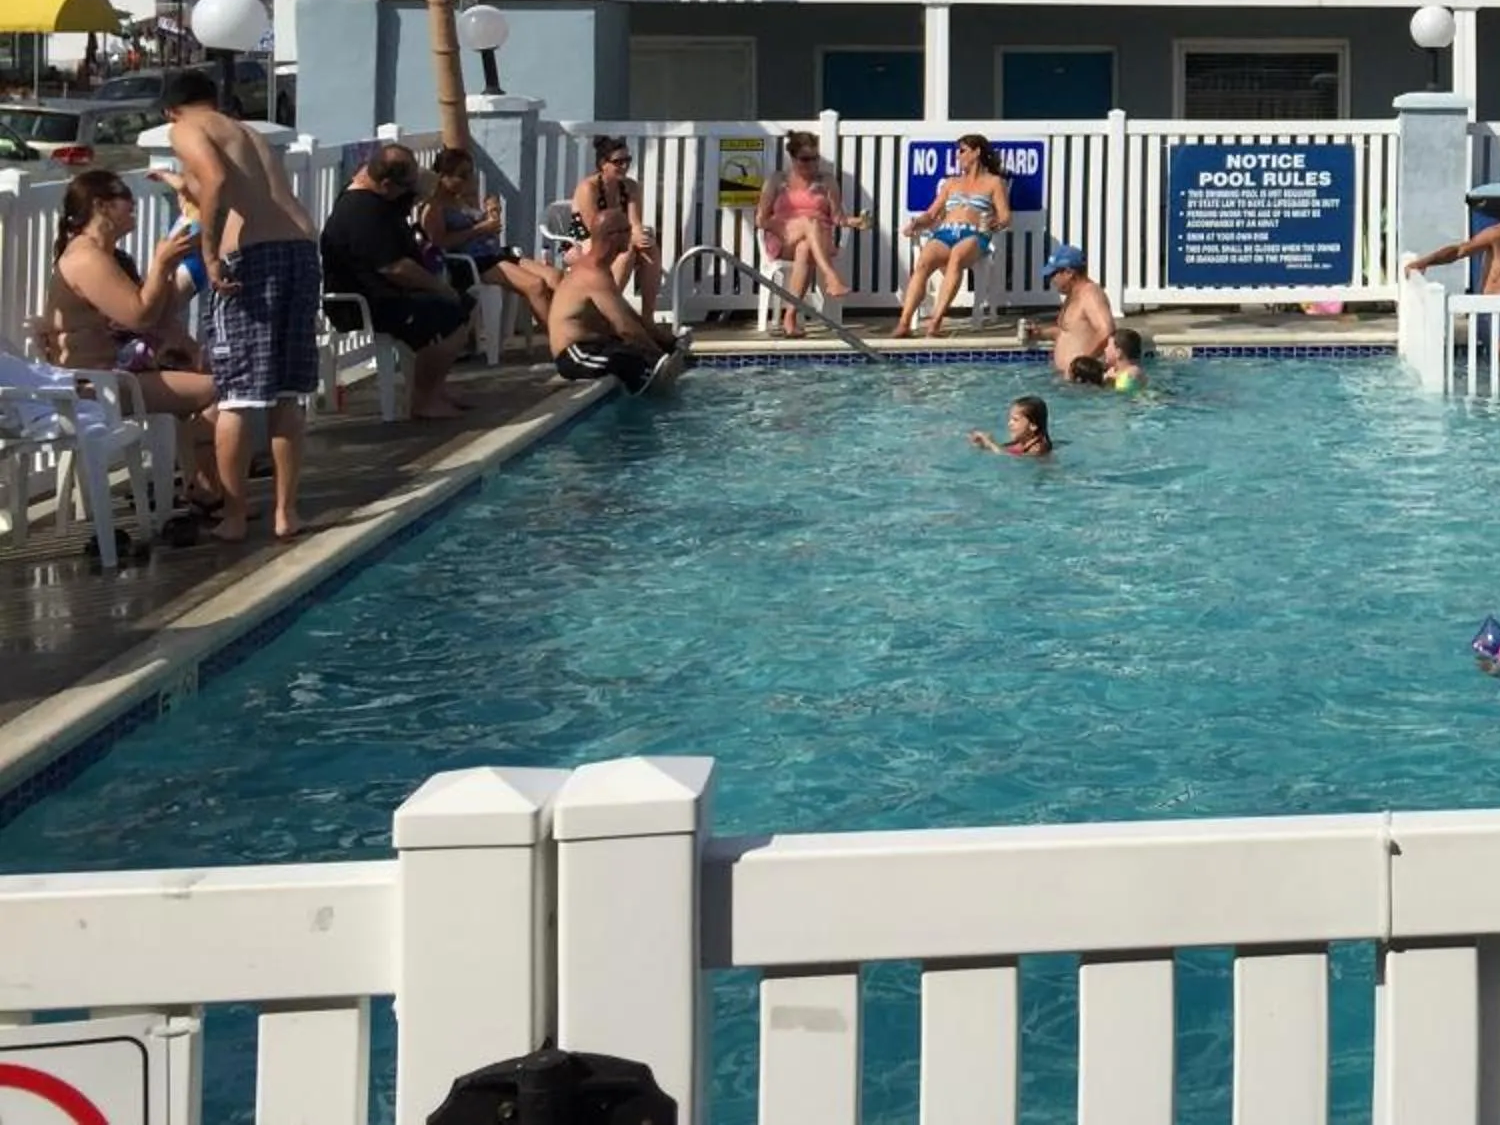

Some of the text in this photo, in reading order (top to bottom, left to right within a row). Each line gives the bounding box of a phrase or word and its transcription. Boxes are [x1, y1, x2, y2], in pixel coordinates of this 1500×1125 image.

[913, 148, 937, 176] NO
[1226, 154, 1306, 169] NOTICE
[1199, 172, 1332, 187] POOL RULES
[1242, 189, 1258, 198] POOL
[1260, 189, 1266, 198] IS
[1187, 199, 1196, 208] BY
[1199, 199, 1220, 208] STATE
[1222, 199, 1236, 208] LAW
[1237, 199, 1246, 208] TO
[1248, 199, 1264, 208] HAVE
[1312, 199, 1320, 208] ON
[1322, 199, 1340, 208] DUTY
[1244, 209, 1256, 218] THE
[1272, 209, 1280, 218] OF
[1312, 209, 1320, 218] BE
[1236, 219, 1244, 228] BY
[1246, 219, 1256, 228] AN
[1258, 219, 1279, 228] ADULT
[1206, 232, 1214, 242] AT
[1216, 232, 1234, 242] YOUR
[1236, 232, 1252, 242] OWN
[1202, 244, 1219, 253] POOL
[1244, 244, 1252, 253] BE
[1186, 254, 1194, 263] OR
[1254, 254, 1264, 263] ON
[1266, 254, 1278, 263] THE
